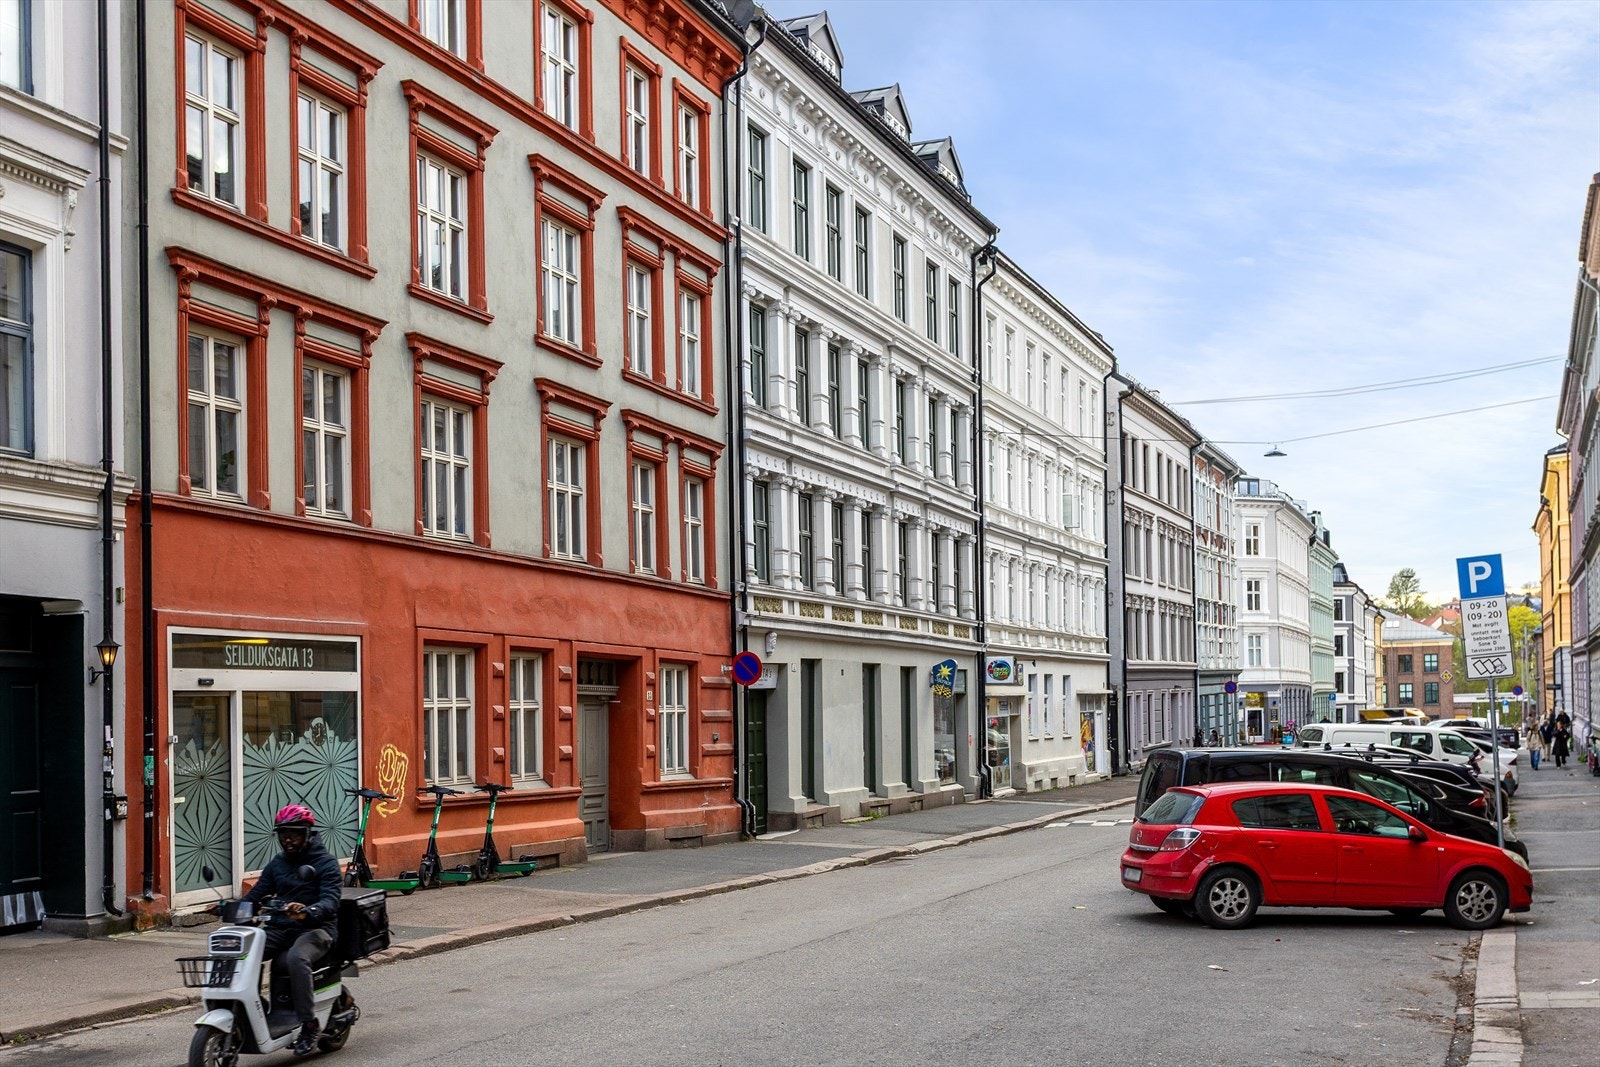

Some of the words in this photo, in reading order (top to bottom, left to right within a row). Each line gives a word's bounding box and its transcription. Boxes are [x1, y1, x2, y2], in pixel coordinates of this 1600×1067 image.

[1468, 561, 1492, 593] P
[225, 644, 299, 668] SEILDUKSGATA
[302, 647, 314, 669] 13
